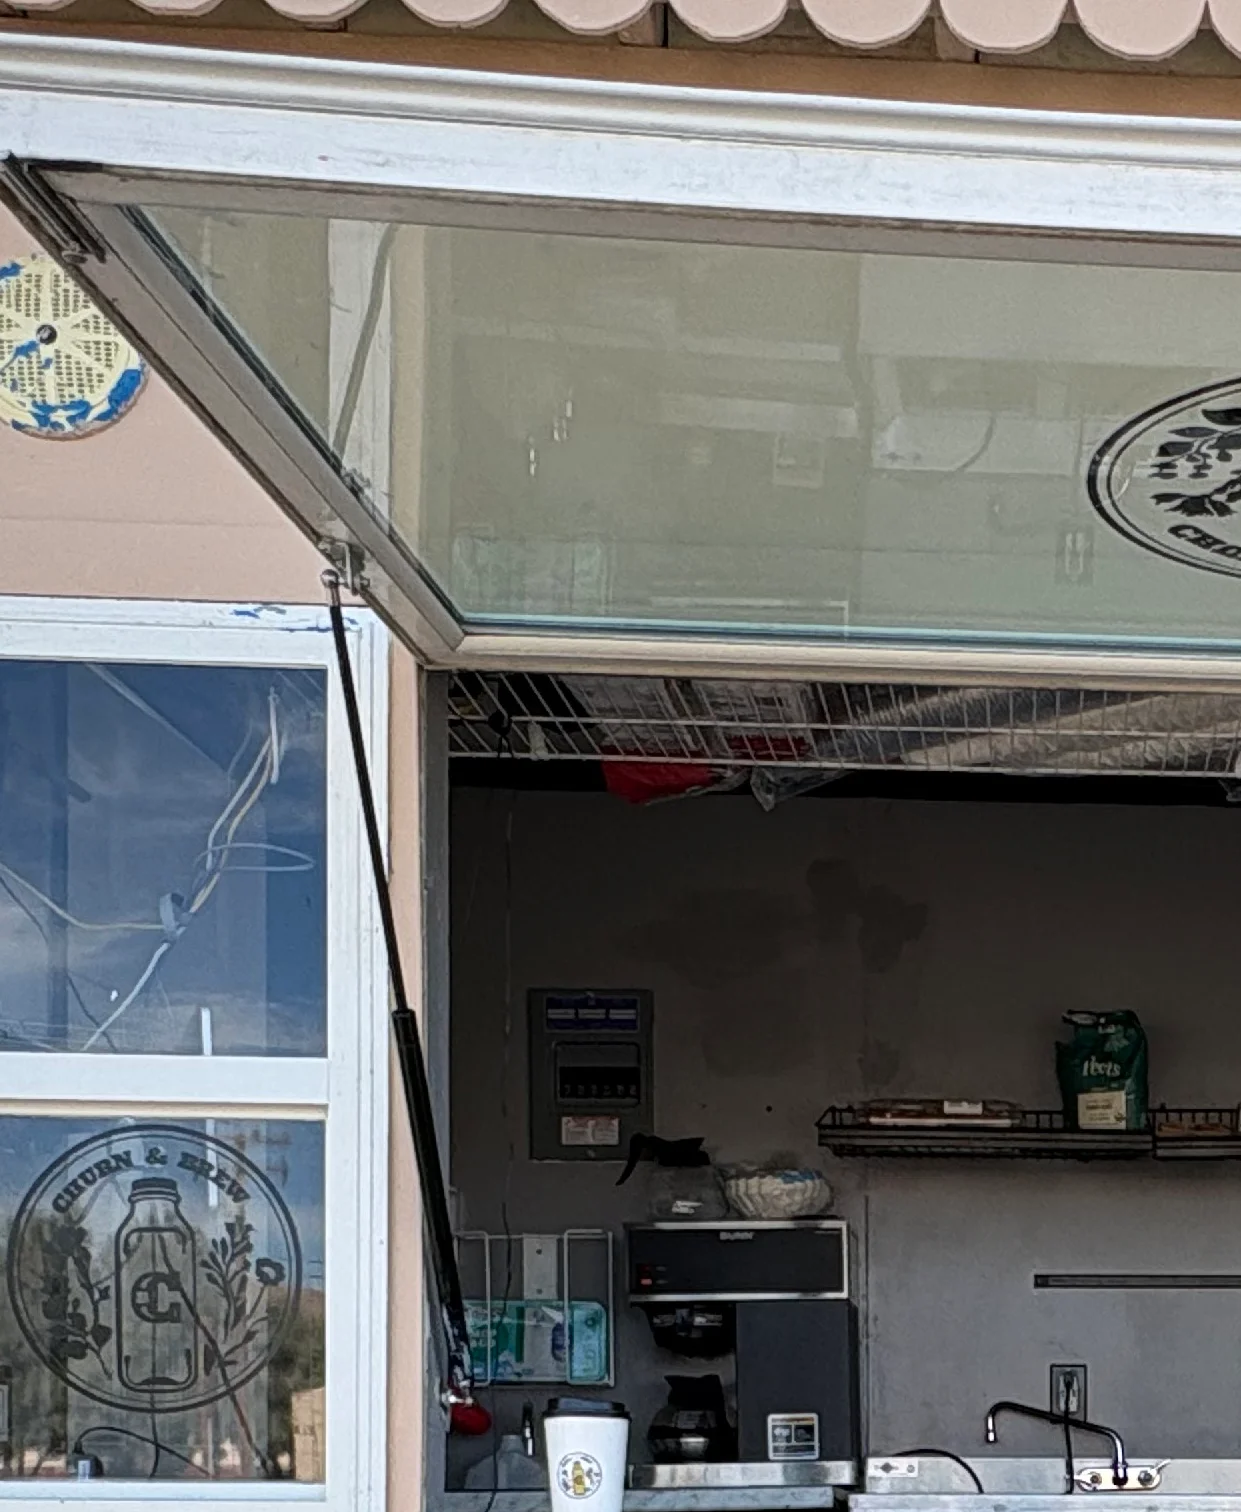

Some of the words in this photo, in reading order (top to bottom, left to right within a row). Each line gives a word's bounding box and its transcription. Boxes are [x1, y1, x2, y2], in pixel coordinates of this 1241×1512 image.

[51, 1150, 134, 1214] CHURN
[145, 1146, 169, 1166] &
[177, 1151, 251, 1204] BREW
